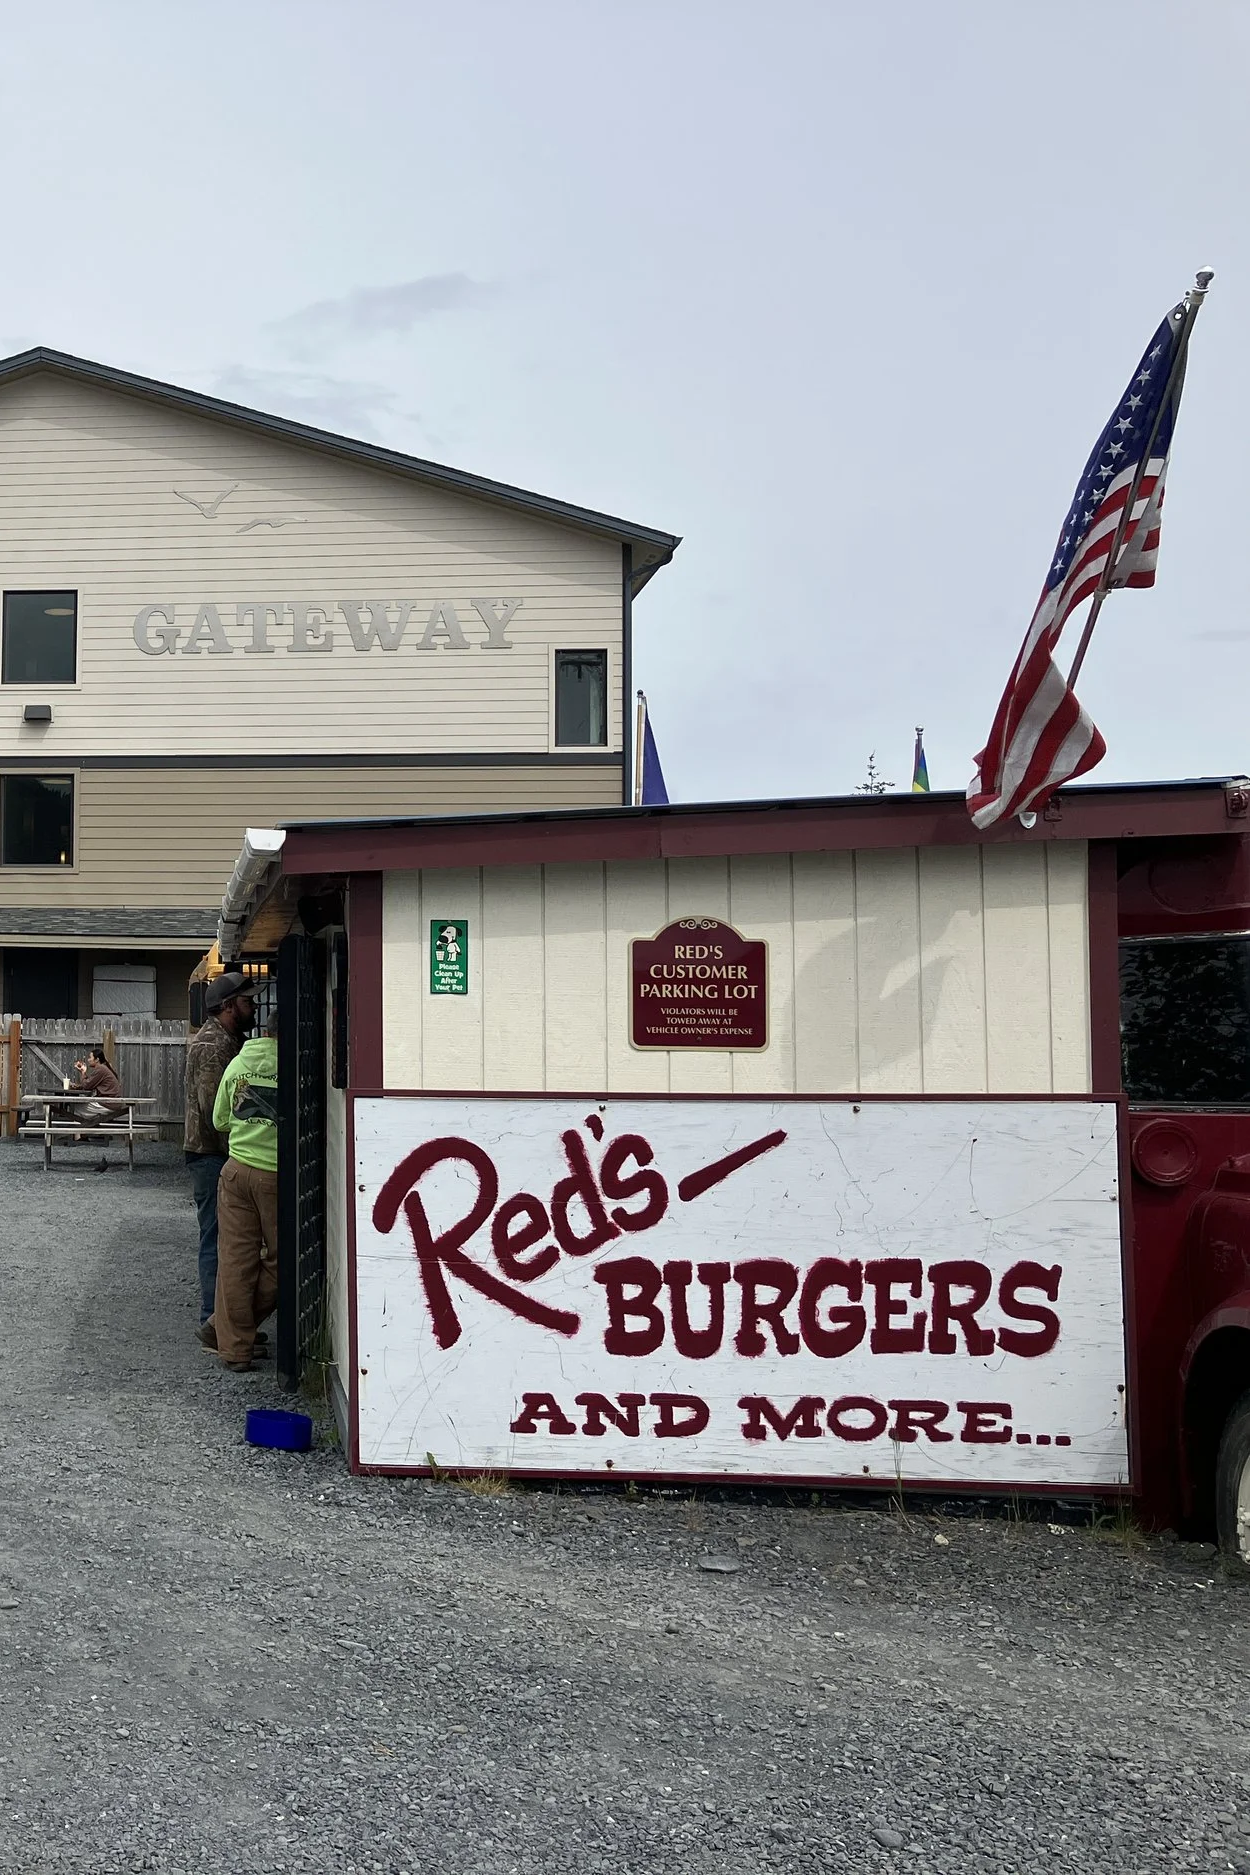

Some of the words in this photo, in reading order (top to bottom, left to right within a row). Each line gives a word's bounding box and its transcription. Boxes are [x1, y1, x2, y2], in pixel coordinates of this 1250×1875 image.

[133, 600, 523, 655] GATEWAY
[674, 945, 724, 959] RED'S
[650, 964, 748, 979] CUSTOMER
[640, 983, 718, 998] PARKING
[724, 985, 758, 999] LOT
[661, 1007, 706, 1015] VIOLATORS
[707, 1008, 726, 1016] WILL
[728, 1008, 738, 1016] BE
[666, 1017, 696, 1025] TOWED
[646, 1026, 679, 1034] VEHICLE
[680, 1027, 718, 1035] OWNER'S
[720, 1027, 753, 1035] EXPENSE
[372, 1114, 669, 1350] Red's
[593, 1256, 1063, 1359] BURGERS
[510, 1393, 710, 1438] AND
[736, 1395, 1072, 1447] MORE...
